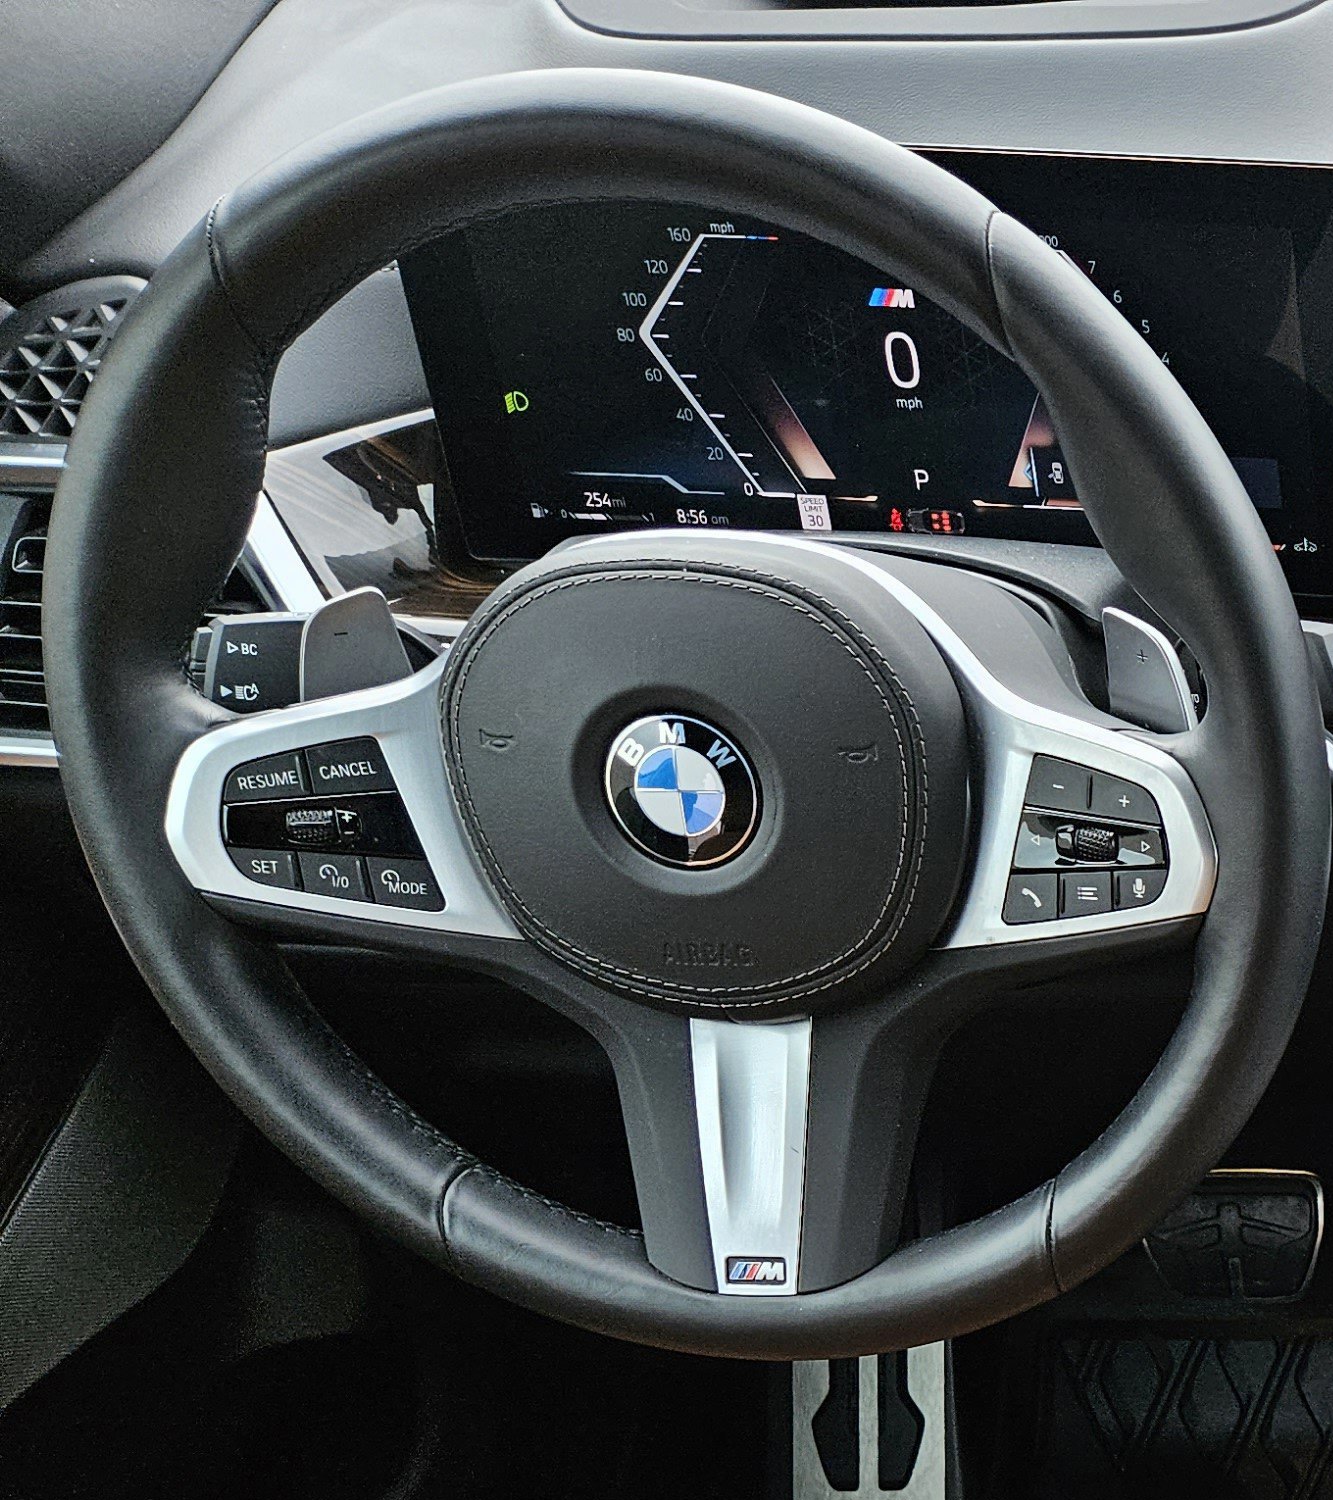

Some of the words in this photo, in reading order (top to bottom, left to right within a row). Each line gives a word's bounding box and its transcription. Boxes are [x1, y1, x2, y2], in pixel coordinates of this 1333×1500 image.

[666, 227, 692, 242] 160
[709, 221, 736, 234] mph
[643, 259, 669, 274] 120
[1087, 260, 1097, 275] 7
[622, 292, 647, 307] 100
[1112, 289, 1123, 304] 6
[1140, 319, 1151, 334] 5
[616, 327, 635, 343] 80
[884, 331, 921, 389] 0
[1161, 351, 1170, 366] 4
[644, 367, 663, 382] 60
[895, 396, 924, 411] mph
[675, 407, 694, 422] 40
[705, 446, 724, 461] 20
[913, 468, 930, 491] P
[743, 481, 754, 496] 0
[800, 496, 825, 505] SPEED
[560, 508, 568, 519] 0
[804, 504, 823, 513] LIMIT
[676, 508, 708, 526] 8:56
[711, 515, 730, 526] am
[808, 514, 825, 528] 30
[240, 642, 259, 656] BC
[617, 721, 737, 770] BMW
[318, 760, 378, 781] CANCEL
[236, 769, 300, 791] RESUME
[251, 859, 278, 875] SET
[388, 881, 428, 896] MODE
